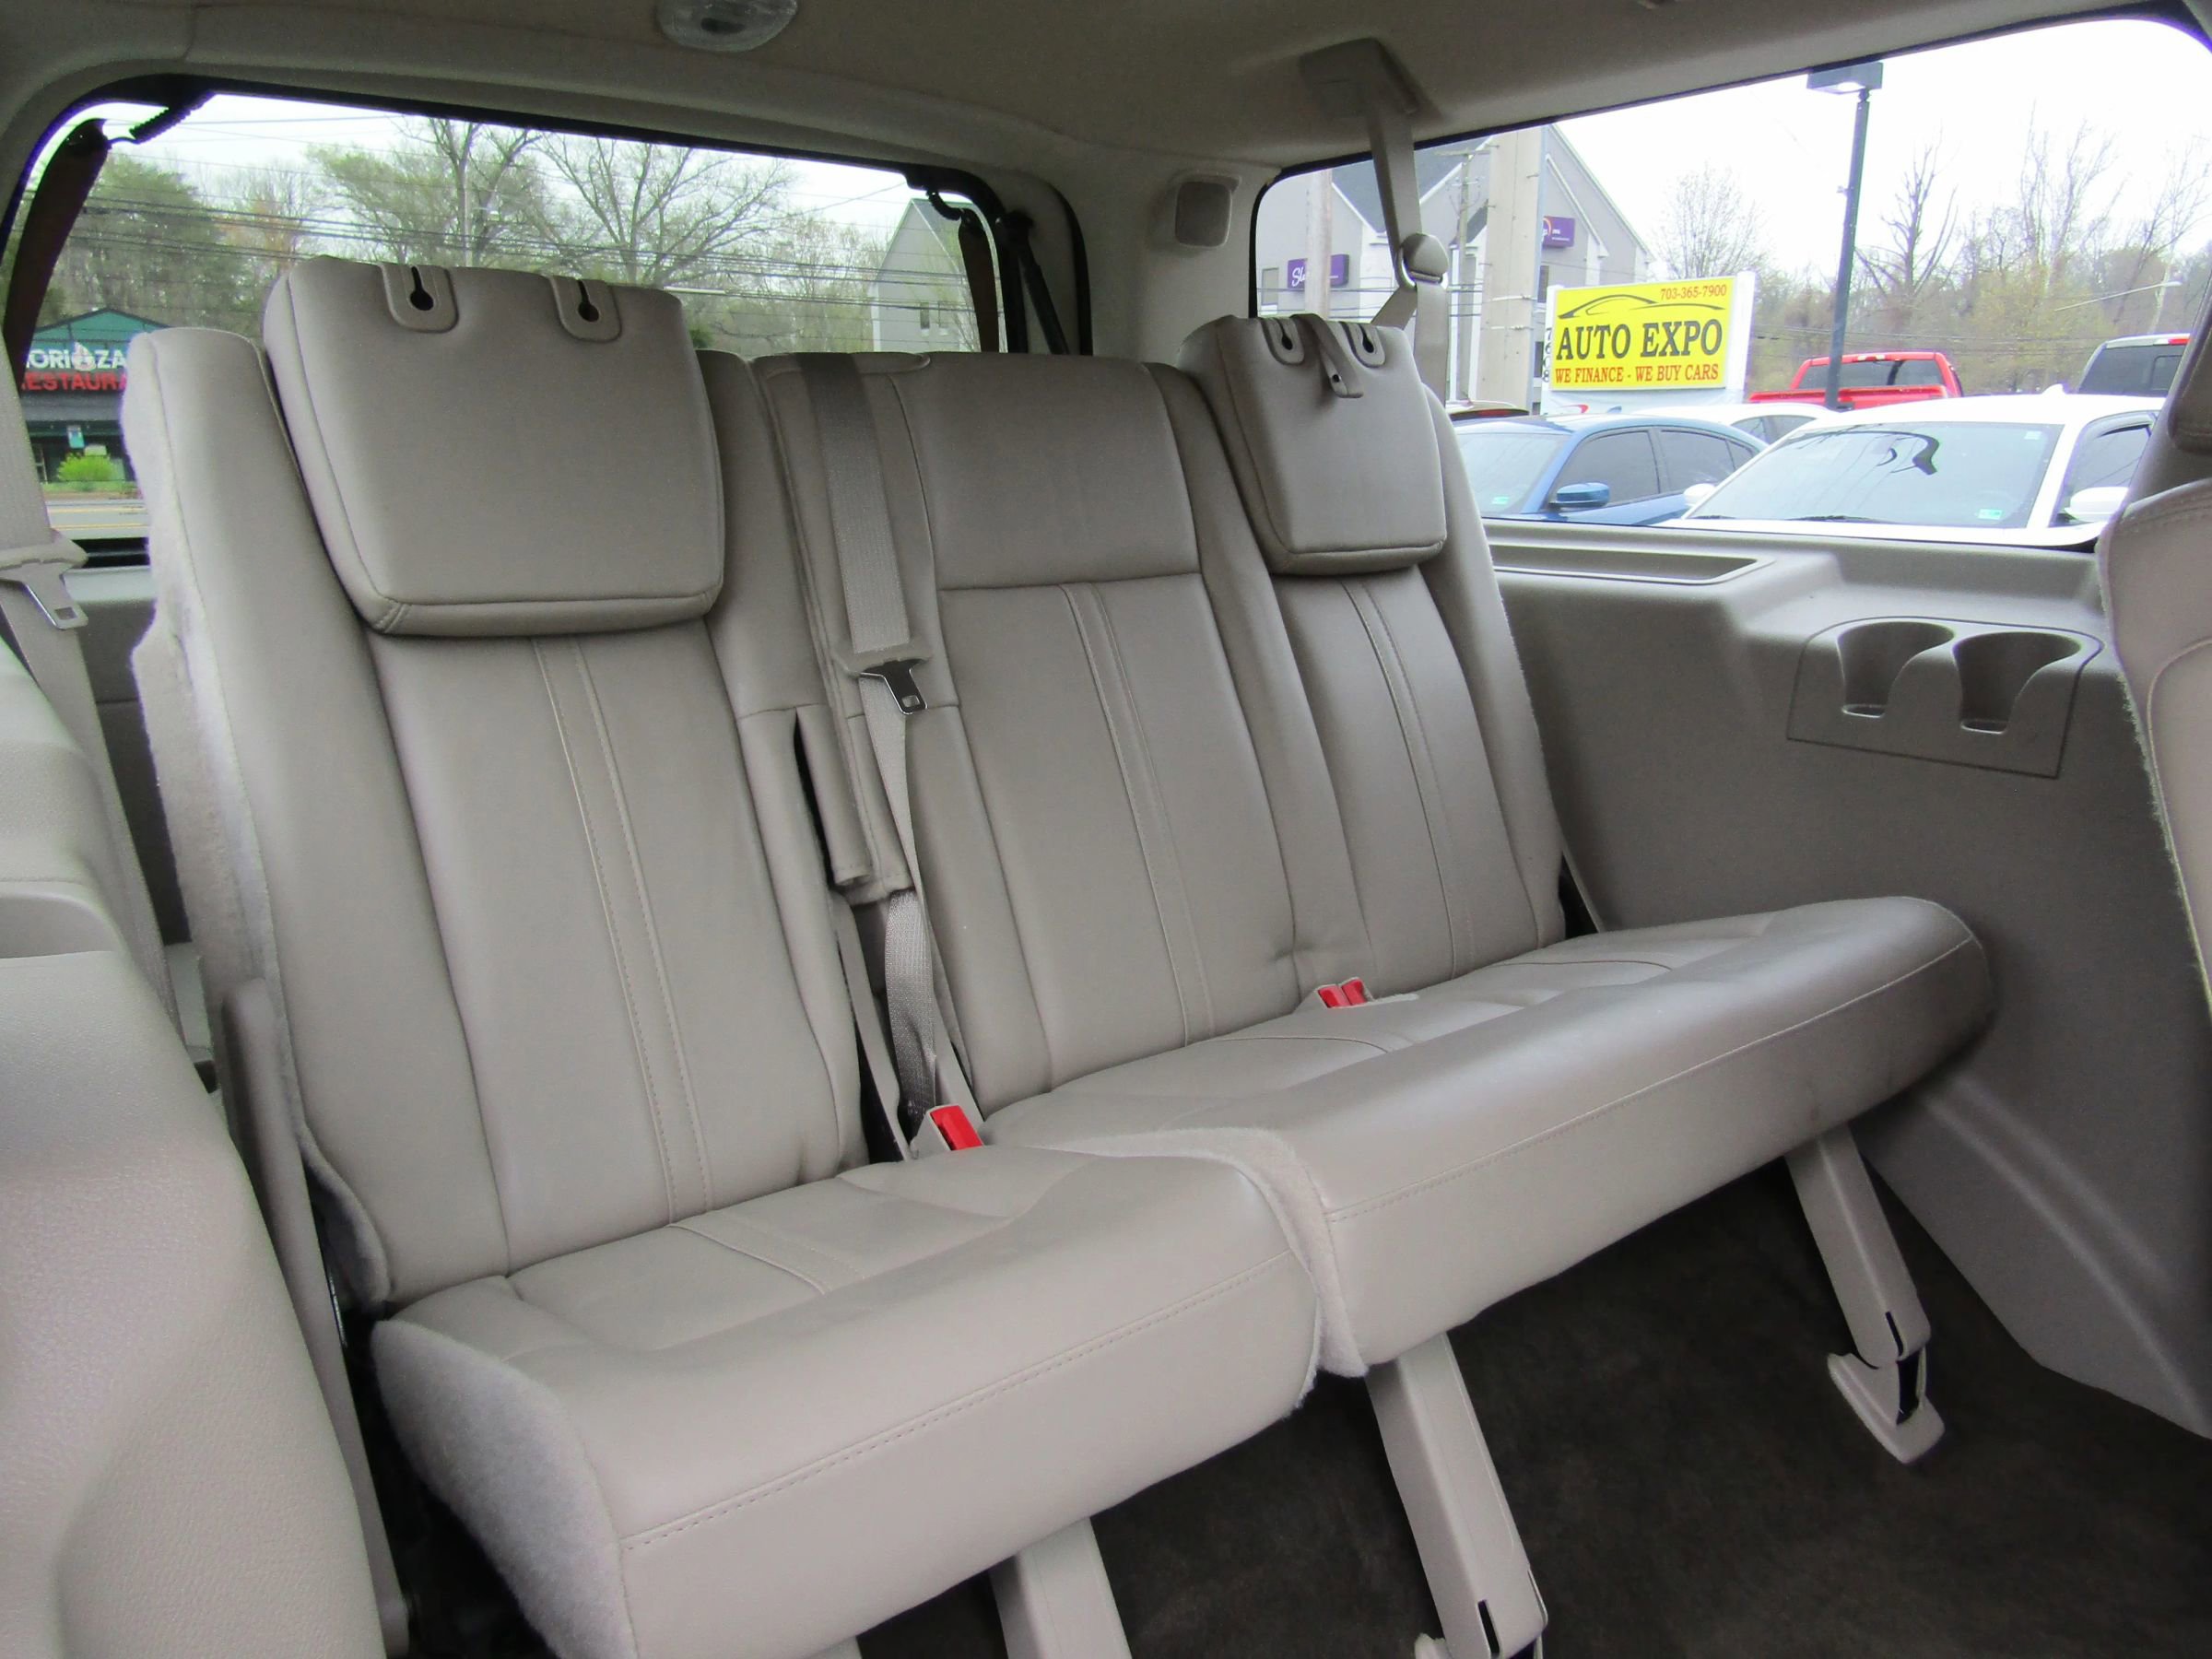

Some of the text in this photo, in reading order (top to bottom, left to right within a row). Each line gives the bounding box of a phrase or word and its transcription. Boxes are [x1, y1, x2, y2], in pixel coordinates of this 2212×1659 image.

[1661, 284, 1726, 300] 703-365-7900
[1556, 318, 1723, 360] AUTO EXPO
[1555, 368, 1571, 383] WE
[1574, 366, 1624, 383] FINANCE
[1635, 365, 1653, 382] WE
[1658, 364, 1681, 382] BUY
[1685, 363, 1719, 381] CARS
